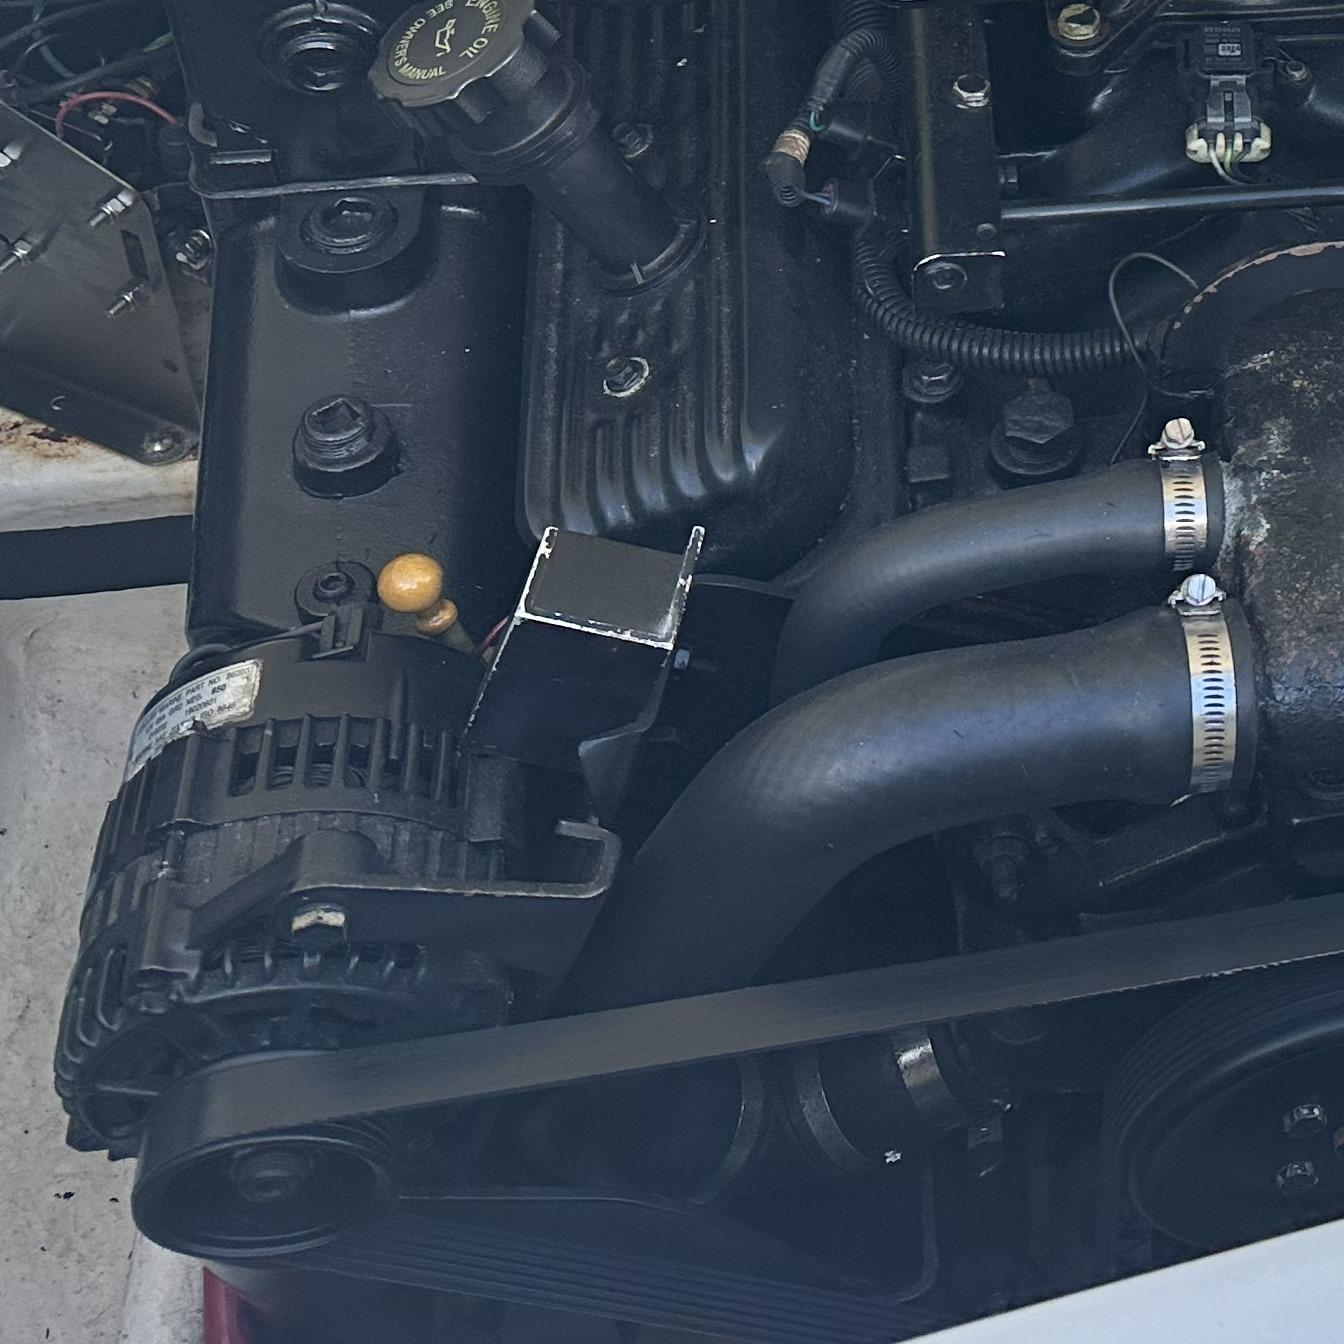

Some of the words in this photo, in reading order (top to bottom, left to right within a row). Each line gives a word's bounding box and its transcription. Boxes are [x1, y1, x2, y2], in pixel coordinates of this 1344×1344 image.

[426, 0, 454, 18] SEE
[459, 37, 489, 59] OIL
[400, 65, 447, 80] MANUAL
